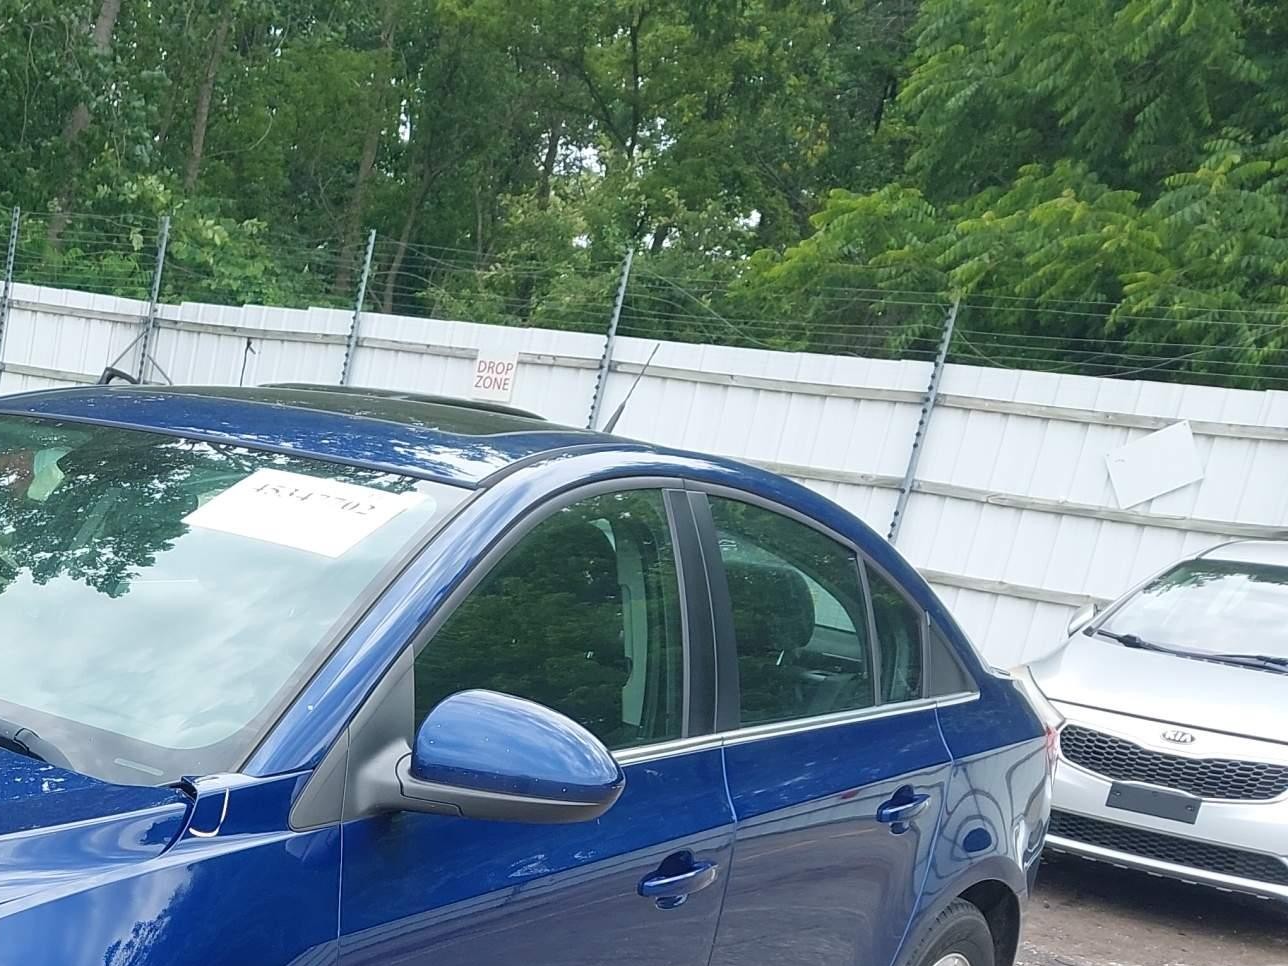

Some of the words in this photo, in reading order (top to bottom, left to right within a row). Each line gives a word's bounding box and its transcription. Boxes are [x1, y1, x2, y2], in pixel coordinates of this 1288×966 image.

[477, 360, 513, 375] DROP
[474, 375, 510, 391] ZONE
[1163, 730, 1194, 743] KIA
